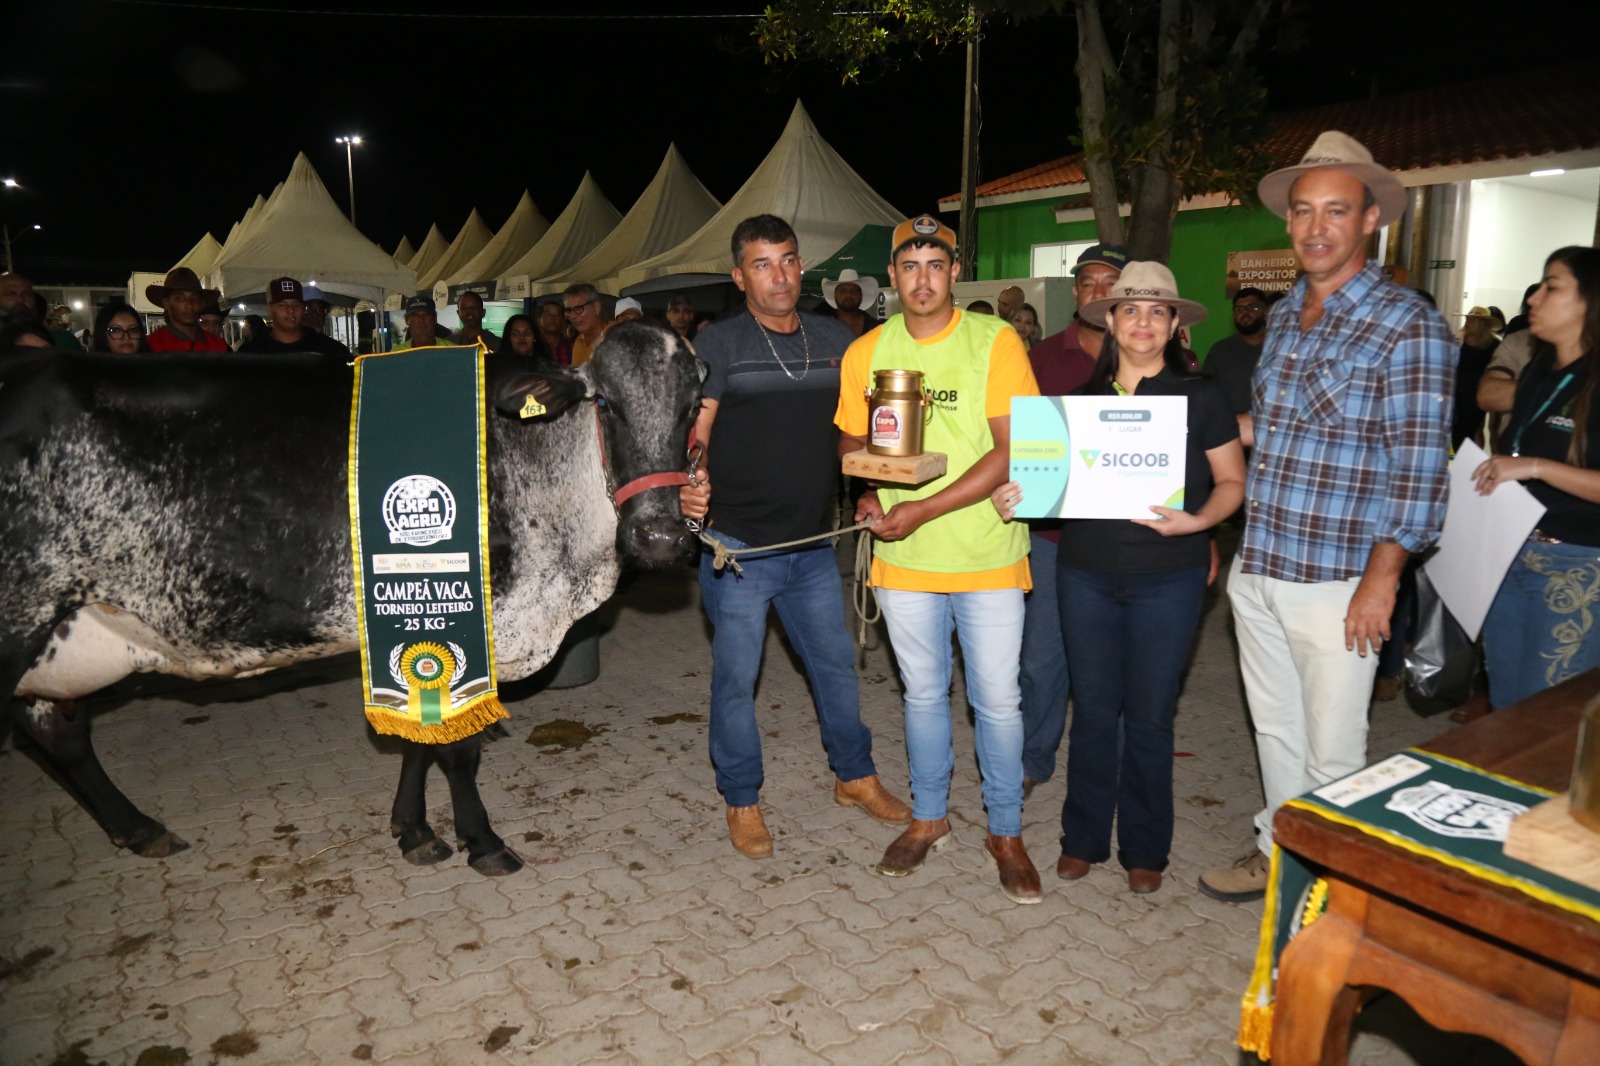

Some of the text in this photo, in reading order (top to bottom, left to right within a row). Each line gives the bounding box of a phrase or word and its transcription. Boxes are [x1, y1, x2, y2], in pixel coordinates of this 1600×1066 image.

[1240, 257, 1295, 269] BANHEIRO
[1238, 269, 1297, 280] EXPOSITOR
[525, 404, 542, 415] 167
[1119, 425, 1143, 433] LUGAR
[1102, 453, 1169, 467] SICOOB
[397, 498, 439, 513] EXPO
[398, 513, 441, 528] AGRO
[373, 578, 473, 601] CAMPEÃ VACA
[374, 601, 474, 615] TORNEIO LEITEIRO
[404, 618, 420, 631] 25
[424, 617, 446, 630] KG
